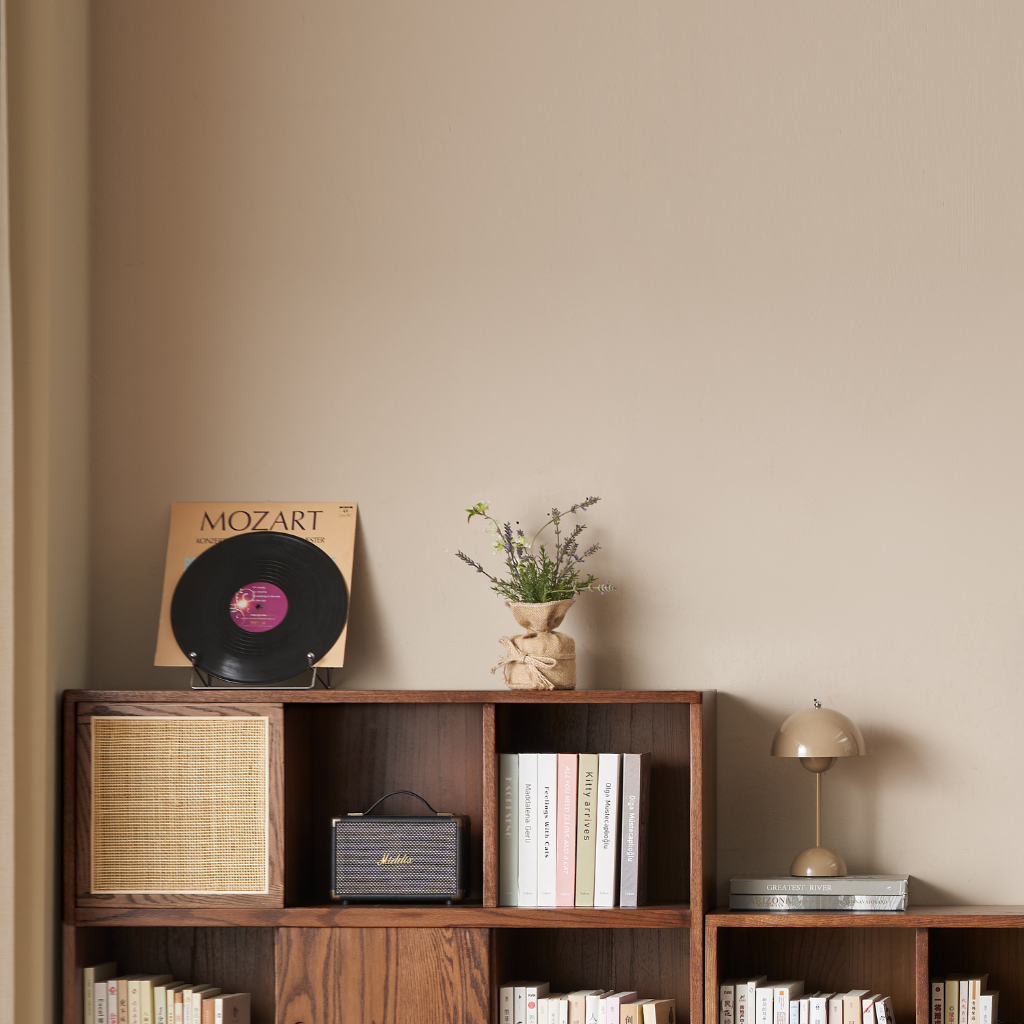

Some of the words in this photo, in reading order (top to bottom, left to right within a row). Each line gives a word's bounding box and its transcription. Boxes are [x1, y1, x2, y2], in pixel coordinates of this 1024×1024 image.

[200, 510, 324, 531] MOZART
[583, 771, 593, 798] Kitty
[603, 782, 612, 799] Olga
[583, 801, 591, 842] arrives
